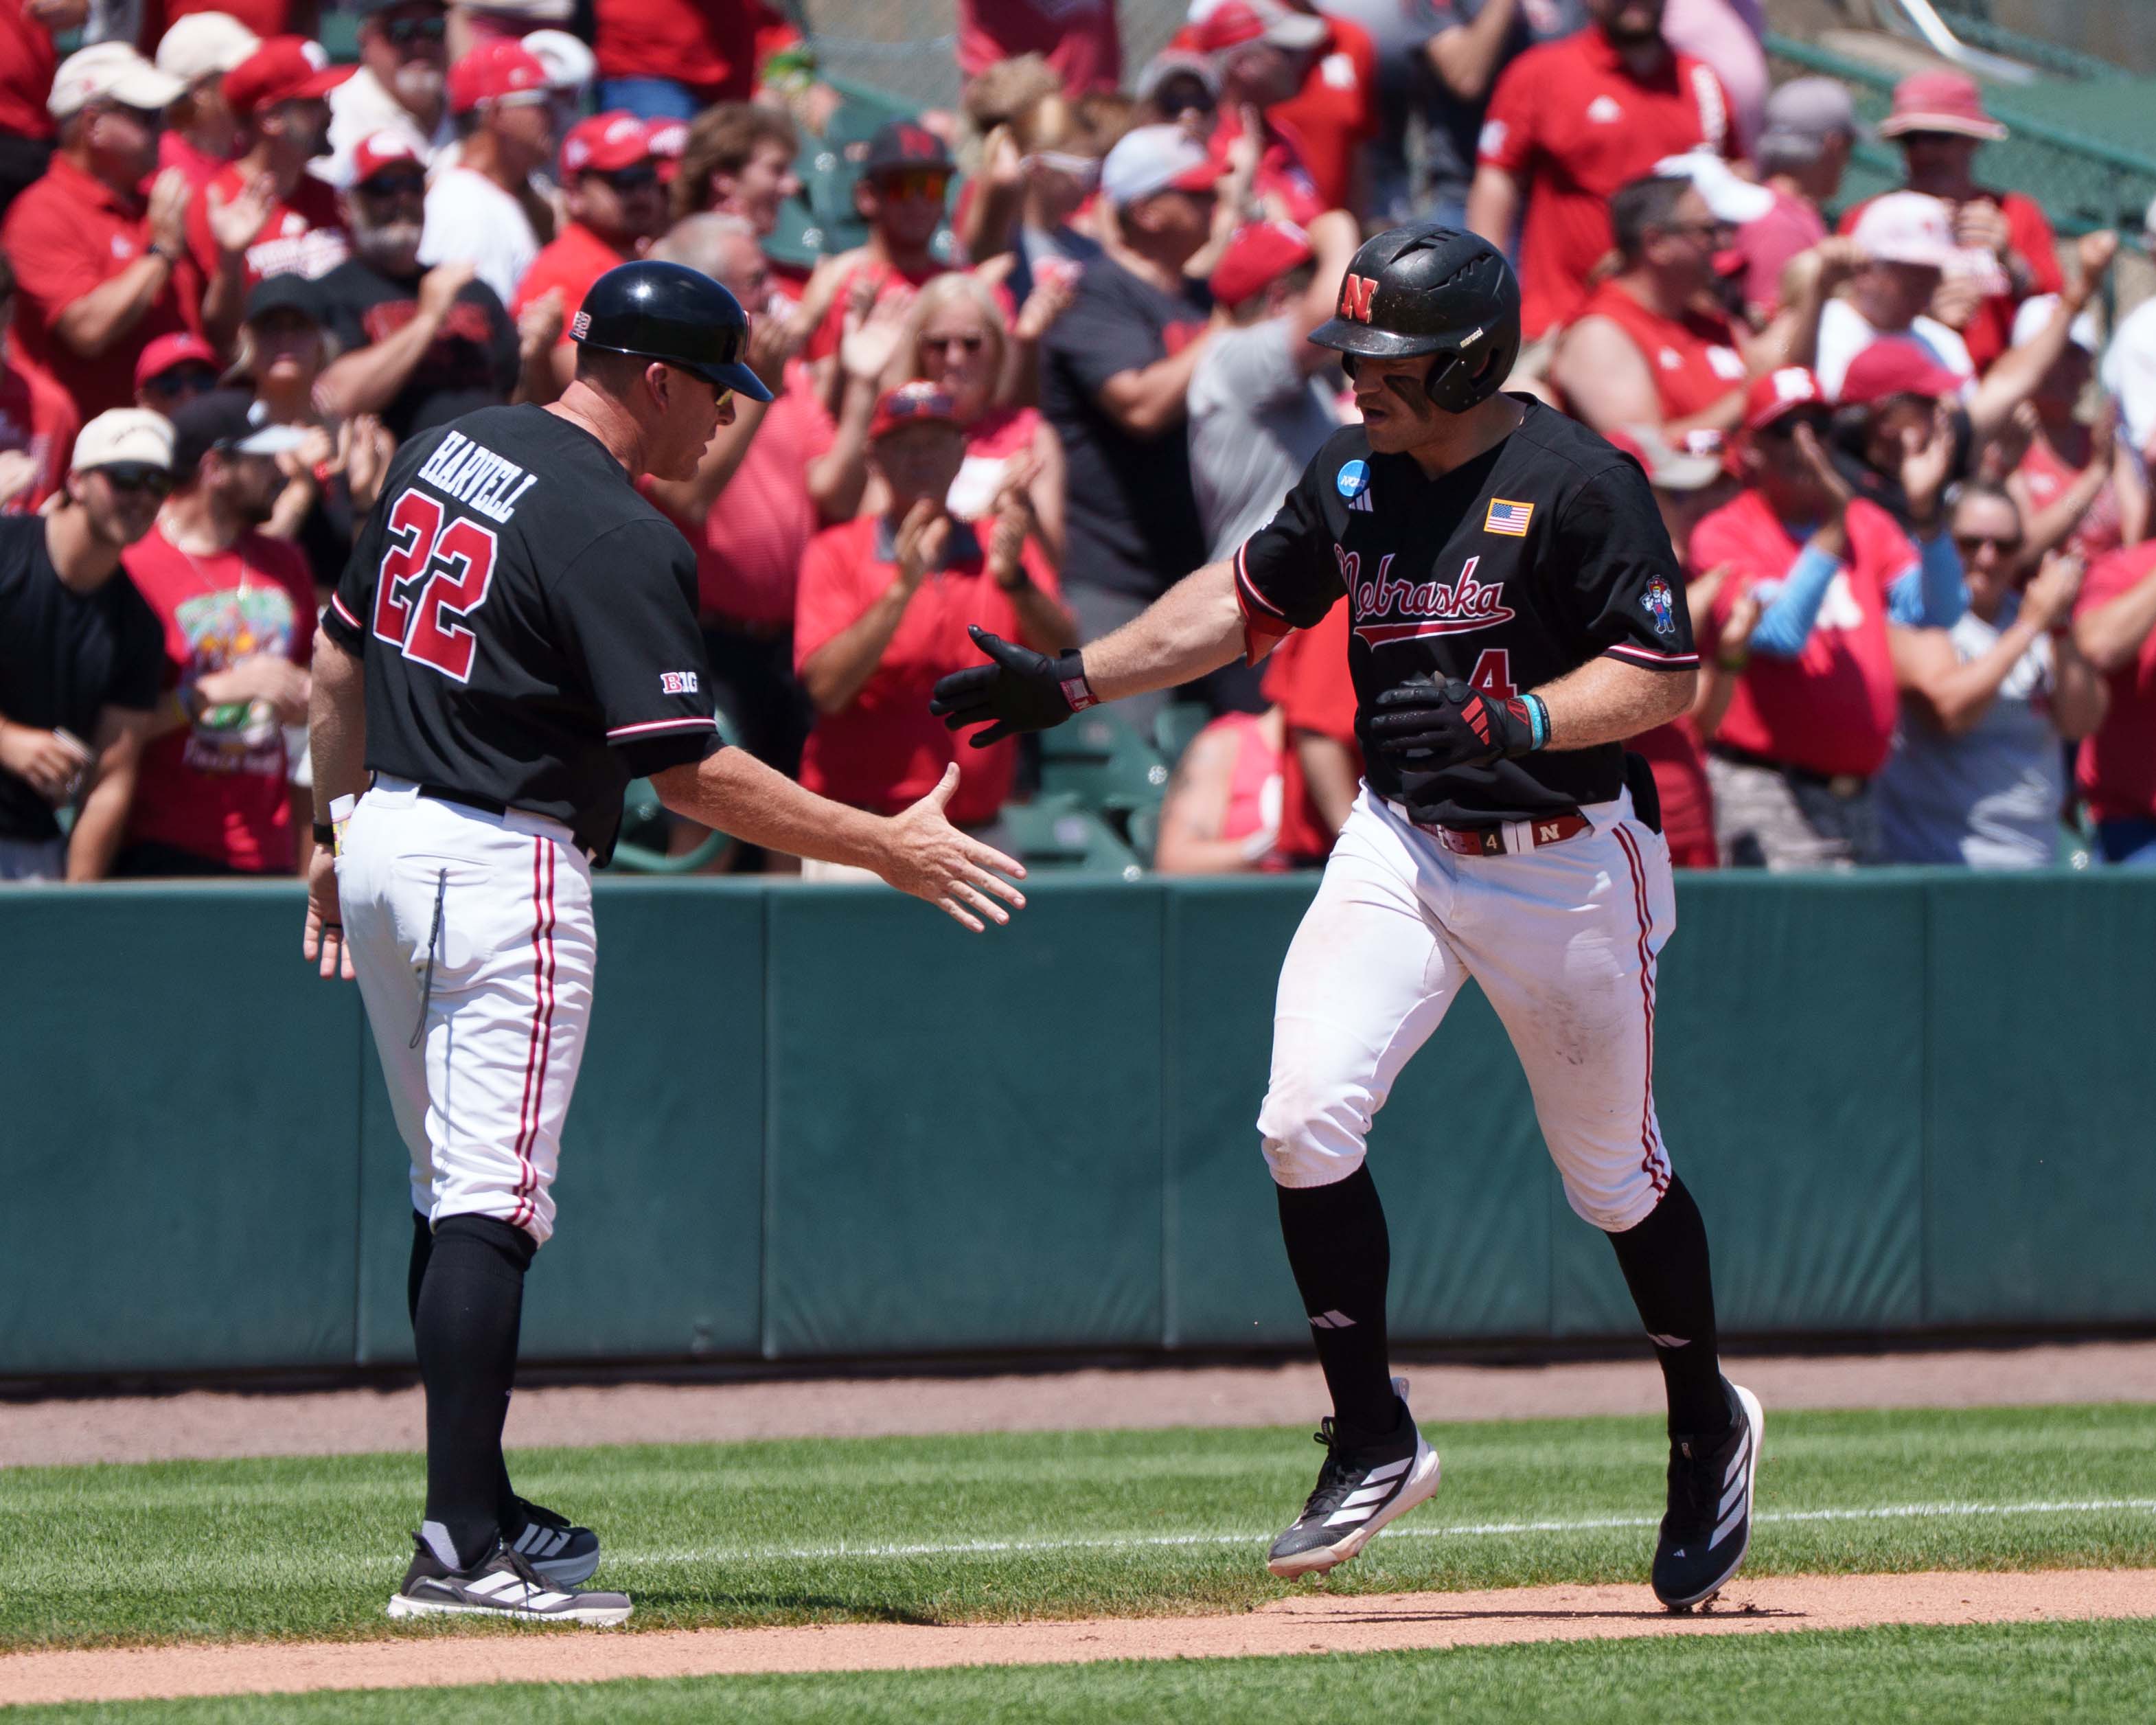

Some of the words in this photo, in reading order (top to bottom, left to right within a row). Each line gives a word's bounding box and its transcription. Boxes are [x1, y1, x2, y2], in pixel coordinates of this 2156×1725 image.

[1340, 273, 1379, 324] N
[1460, 327, 1484, 348] marucci
[417, 430, 538, 524] HARVELL
[373, 487, 498, 684] 22
[1334, 542, 1515, 622] Nebraska
[1467, 648, 1517, 702] 4
[1486, 834, 1498, 849] 4
[1539, 823, 1559, 842] N
